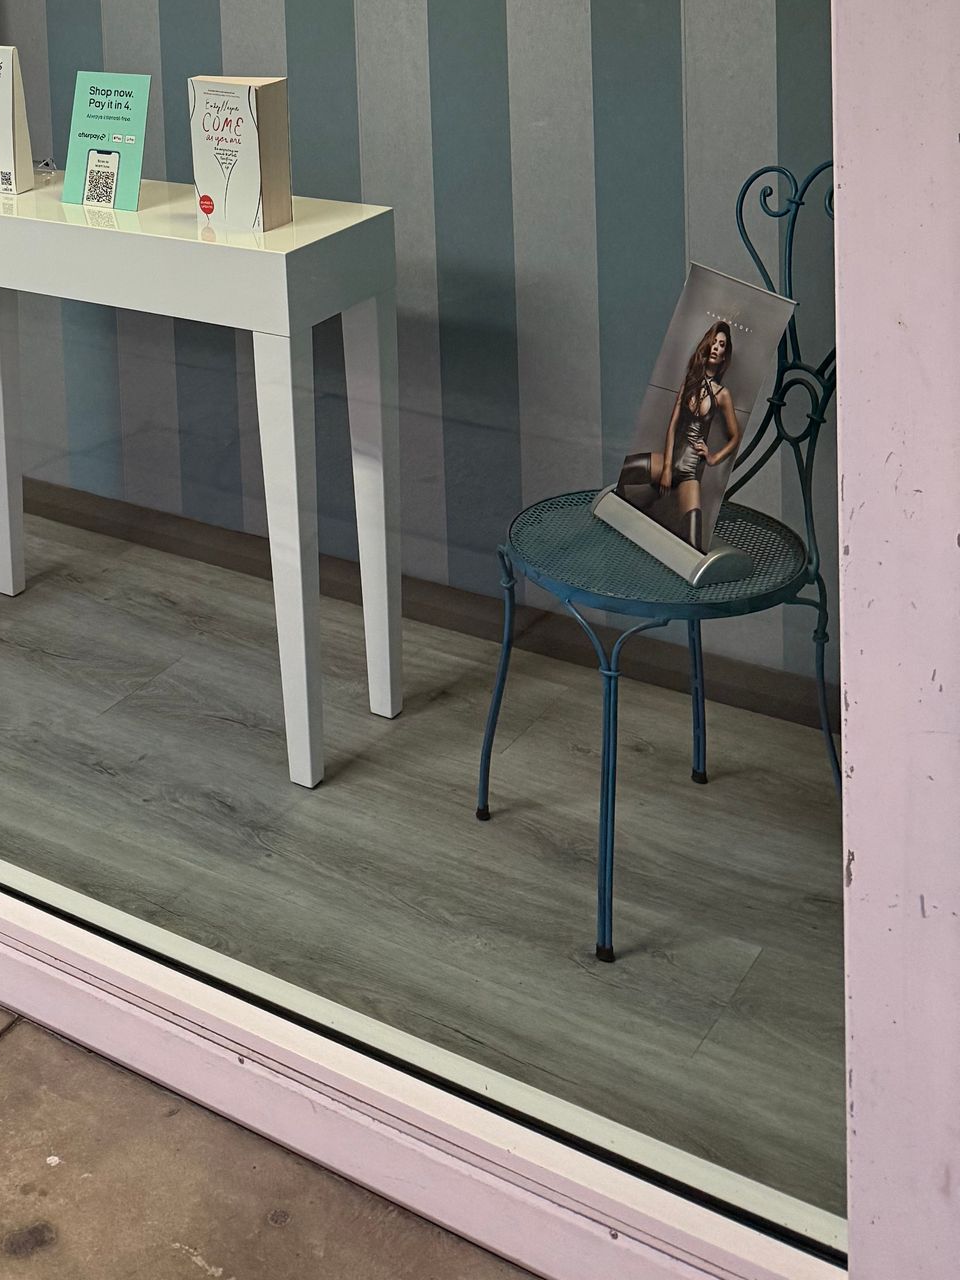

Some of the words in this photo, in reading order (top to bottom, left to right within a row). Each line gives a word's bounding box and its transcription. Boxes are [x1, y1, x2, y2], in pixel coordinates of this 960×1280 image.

[89, 85, 112, 98] Shop
[113, 89, 134, 98] now.
[88, 98, 106, 110] Pay
[107, 99, 113, 109] it
[114, 100, 122, 110] in
[124, 101, 132, 111] 4.
[202, 112, 244, 137] COME
